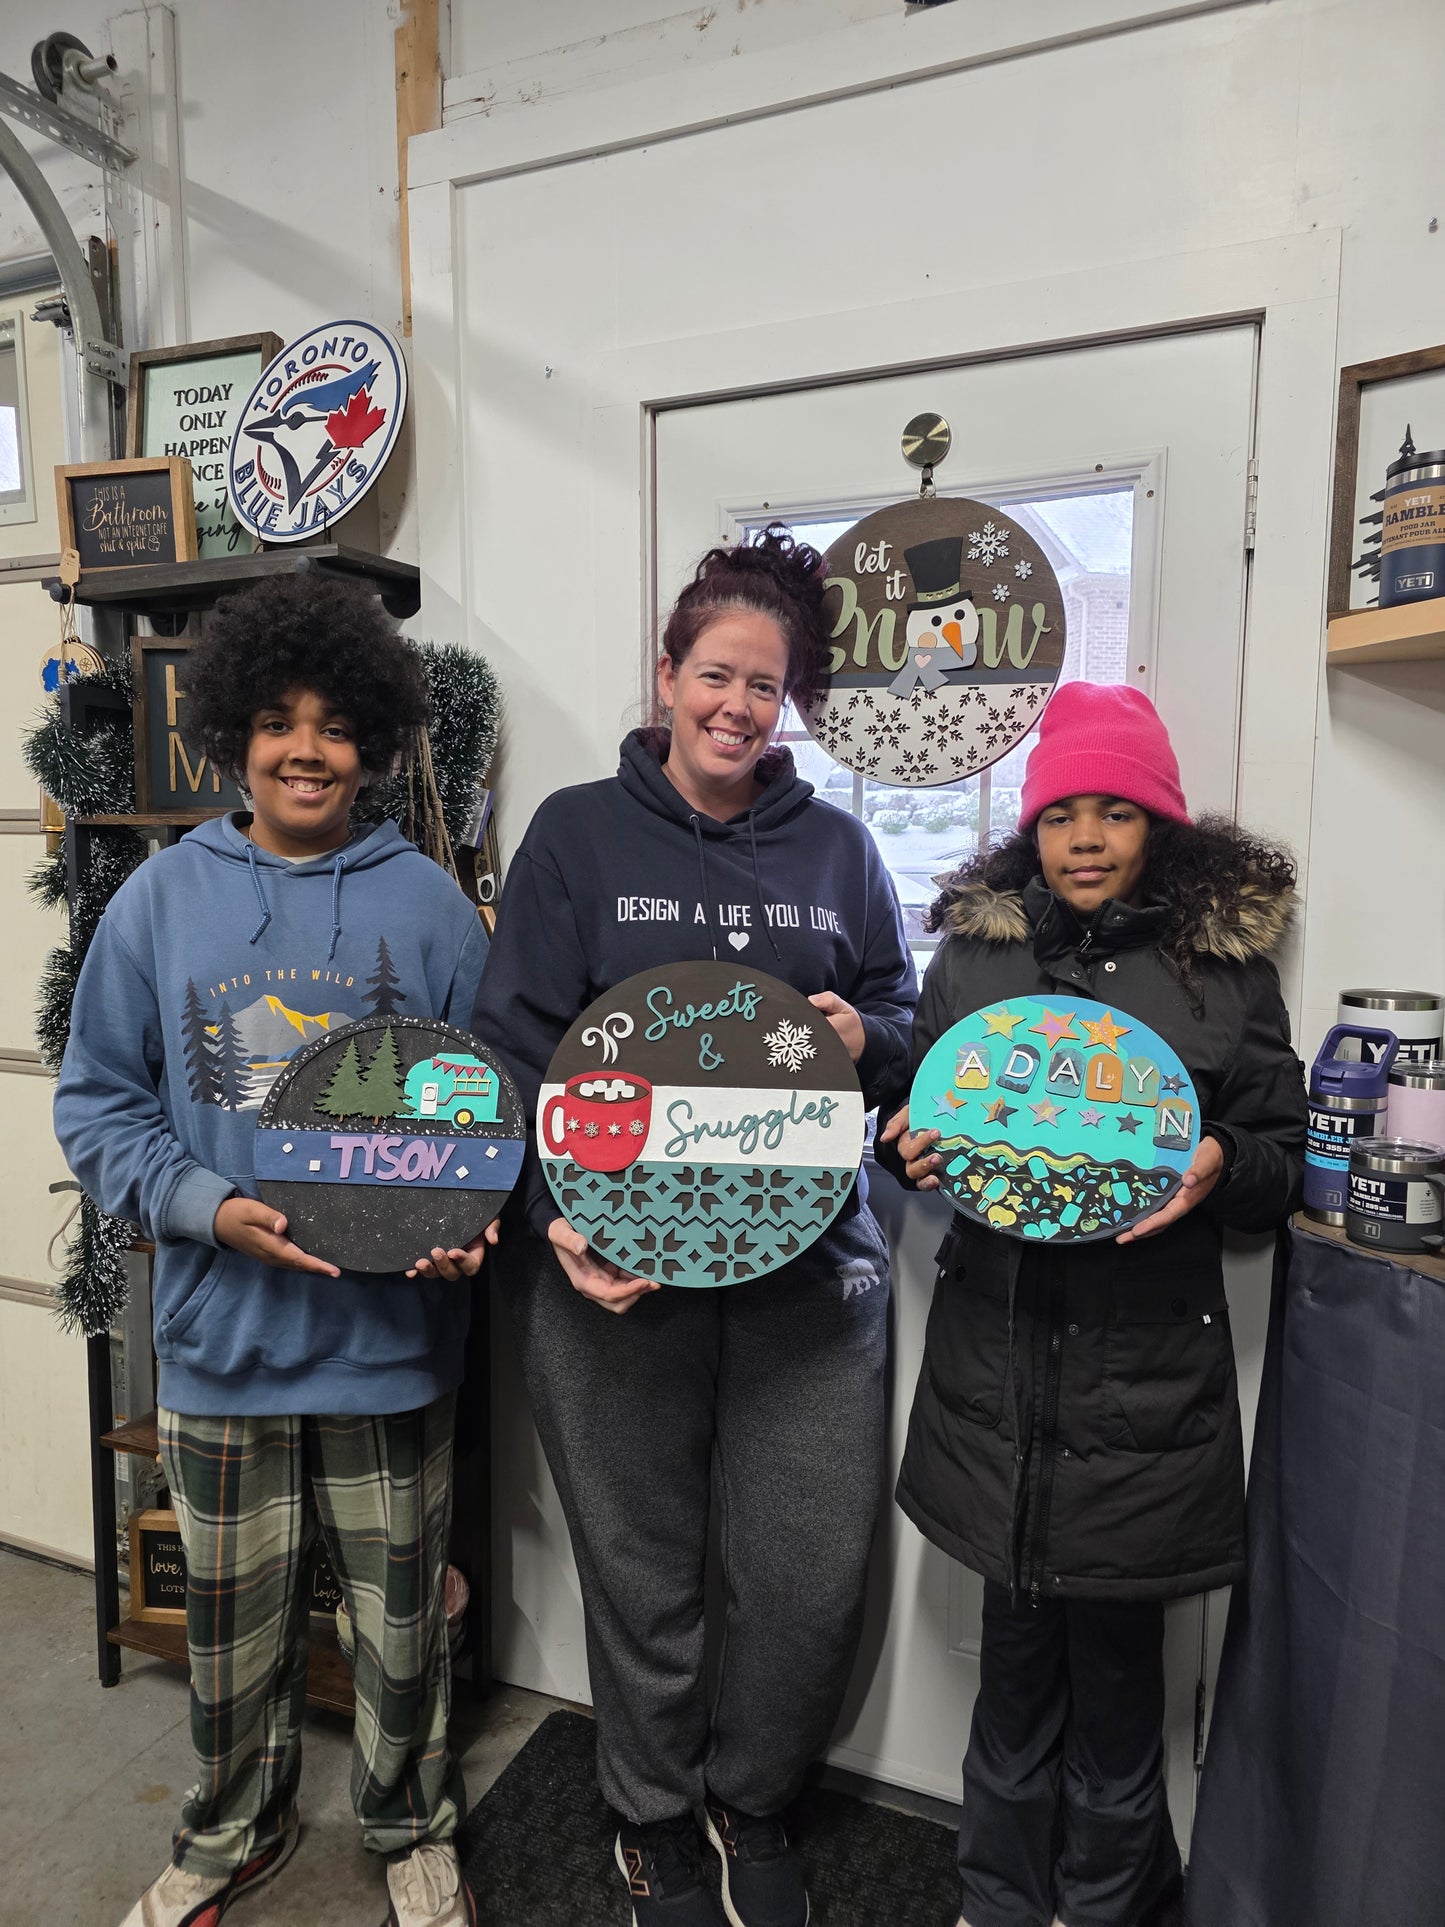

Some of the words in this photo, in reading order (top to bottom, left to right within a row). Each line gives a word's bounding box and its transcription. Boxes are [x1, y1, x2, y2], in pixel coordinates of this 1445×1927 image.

[253, 337, 369, 412] TORONTO
[173, 383, 233, 406] TODAY
[180, 410, 227, 432] ONLY
[164, 435, 232, 457] HAPPEN
[191, 463, 224, 482] NCE
[94, 486, 110, 501] THIS
[111, 485, 119, 499] IS
[120, 485, 126, 499] A
[234, 458, 283, 531] BLUE
[292, 458, 368, 530] JAYS
[1404, 495, 1432, 507] YETI
[82, 497, 169, 532] Bathroom
[1385, 503, 1445, 527] RAMBLE
[98, 526, 110, 540] NOT
[112, 525, 121, 539] AN
[121, 523, 152, 539] INTERNET
[152, 521, 168, 536] CAFE
[195, 522, 245, 552] zing
[1399, 522, 1419, 532] FOOD
[1419, 520, 1436, 528] JAR
[1409, 528, 1432, 537] POUR
[118, 538, 124, 551] &
[854, 540, 893, 575] let
[886, 569, 907, 601] it
[1397, 575, 1431, 588] YETI
[617, 896, 680, 922] DESIGN
[693, 902, 706, 924] A
[718, 904, 752, 927] LIFE
[764, 904, 800, 928] YOU
[810, 905, 842, 934] LOVE
[210, 974, 251, 998] INTO
[265, 968, 297, 981] THE
[311, 969, 354, 987] WILD
[644, 980, 763, 1042] Sweets
[698, 1033, 725, 1071] &
[1366, 1042, 1436, 1064] YETI
[664, 1091, 839, 1157] Snuggles
[1308, 1109, 1355, 1135] YETI
[1307, 1128, 1344, 1144] RAMBLER
[330, 1133, 457, 1182] TYSON
[1350, 1174, 1386, 1196] YETI
[157, 1543, 176, 1552] THIS
[160, 1584, 185, 1593] LOTS
